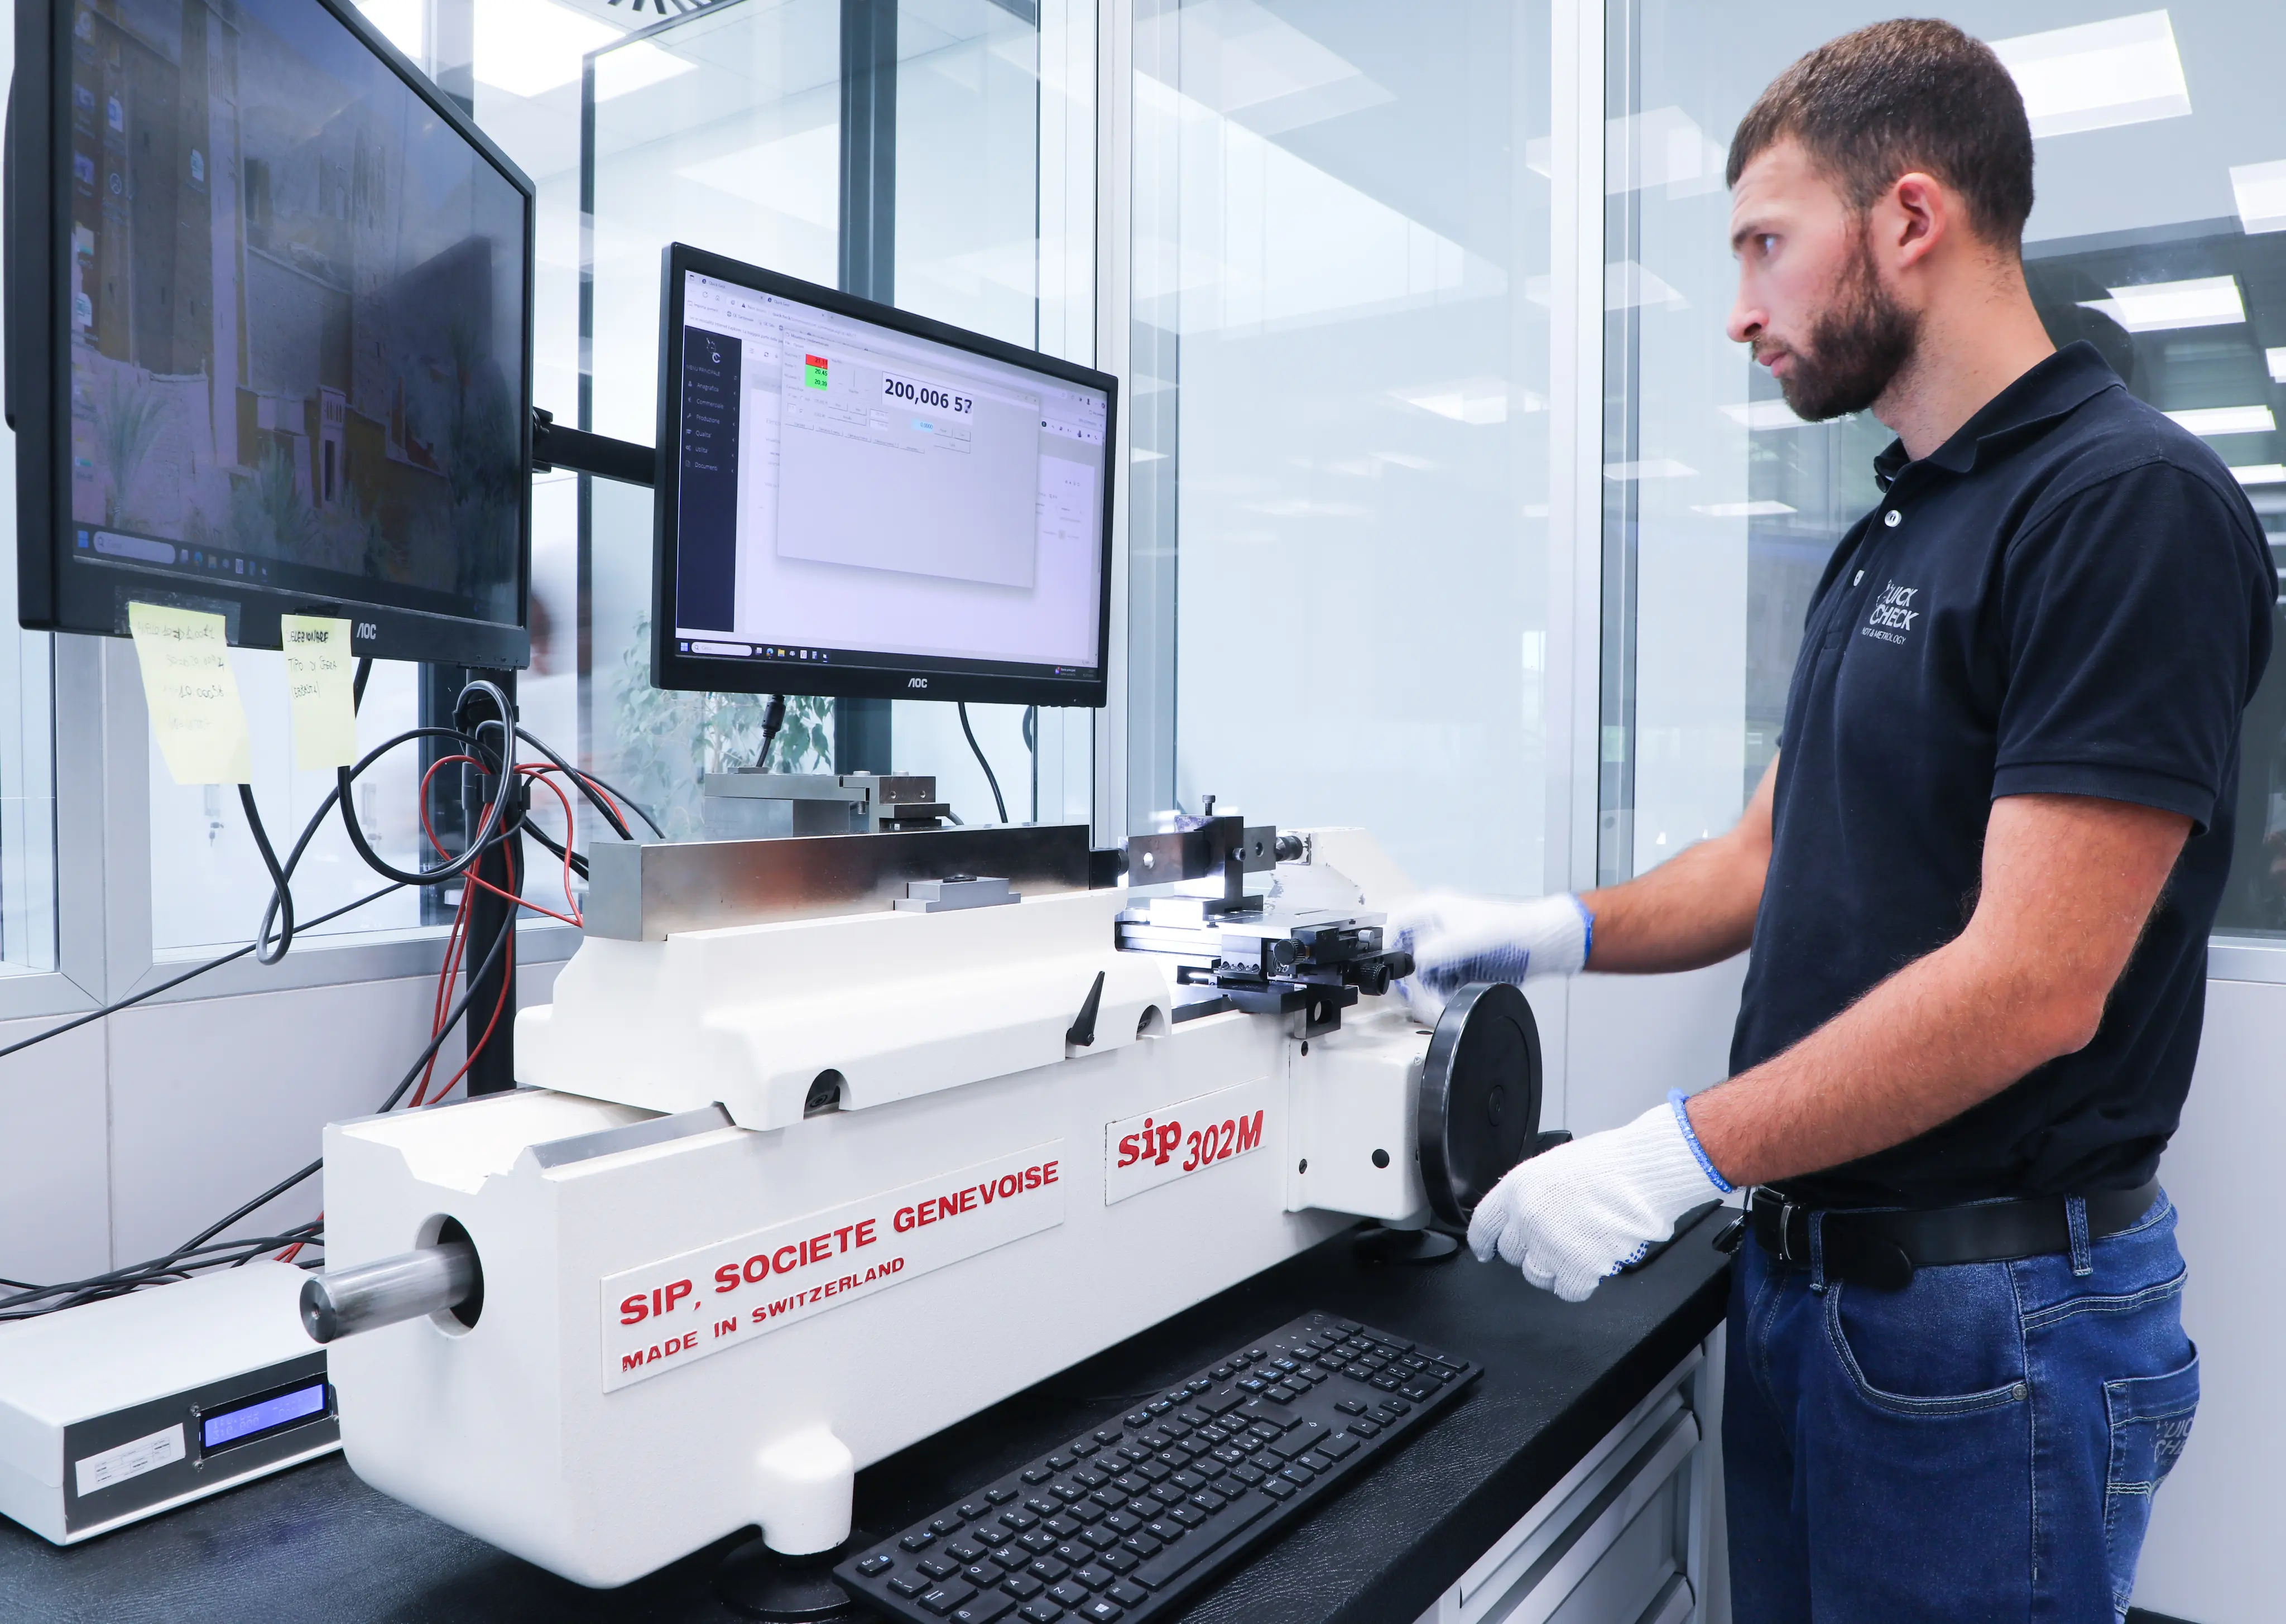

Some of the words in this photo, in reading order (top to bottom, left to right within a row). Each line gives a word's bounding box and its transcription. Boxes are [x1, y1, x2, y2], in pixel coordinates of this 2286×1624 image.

[697, 382, 719, 392] Anagrafica
[885, 378, 949, 409] 200,006
[697, 398, 724, 410] Commerciale
[696, 414, 720, 425] Produzione
[695, 462, 718, 471] Documenti
[1869, 604, 1919, 631] CHECK
[356, 623, 376, 640] AOC
[1875, 630, 1906, 645] METROLOGY
[907, 678, 928, 688] AOC
[1183, 1109, 1264, 1172] 302M
[619, 1278, 702, 1326] SIP,
[714, 1218, 877, 1294] SOCIETE
[892, 1160, 1060, 1234] GENEVOISE
[621, 1330, 699, 1373] MADE
[713, 1316, 737, 1339] IN
[751, 1256, 906, 1324] SWITZERLAND
[997, 1548, 1010, 1556] W
